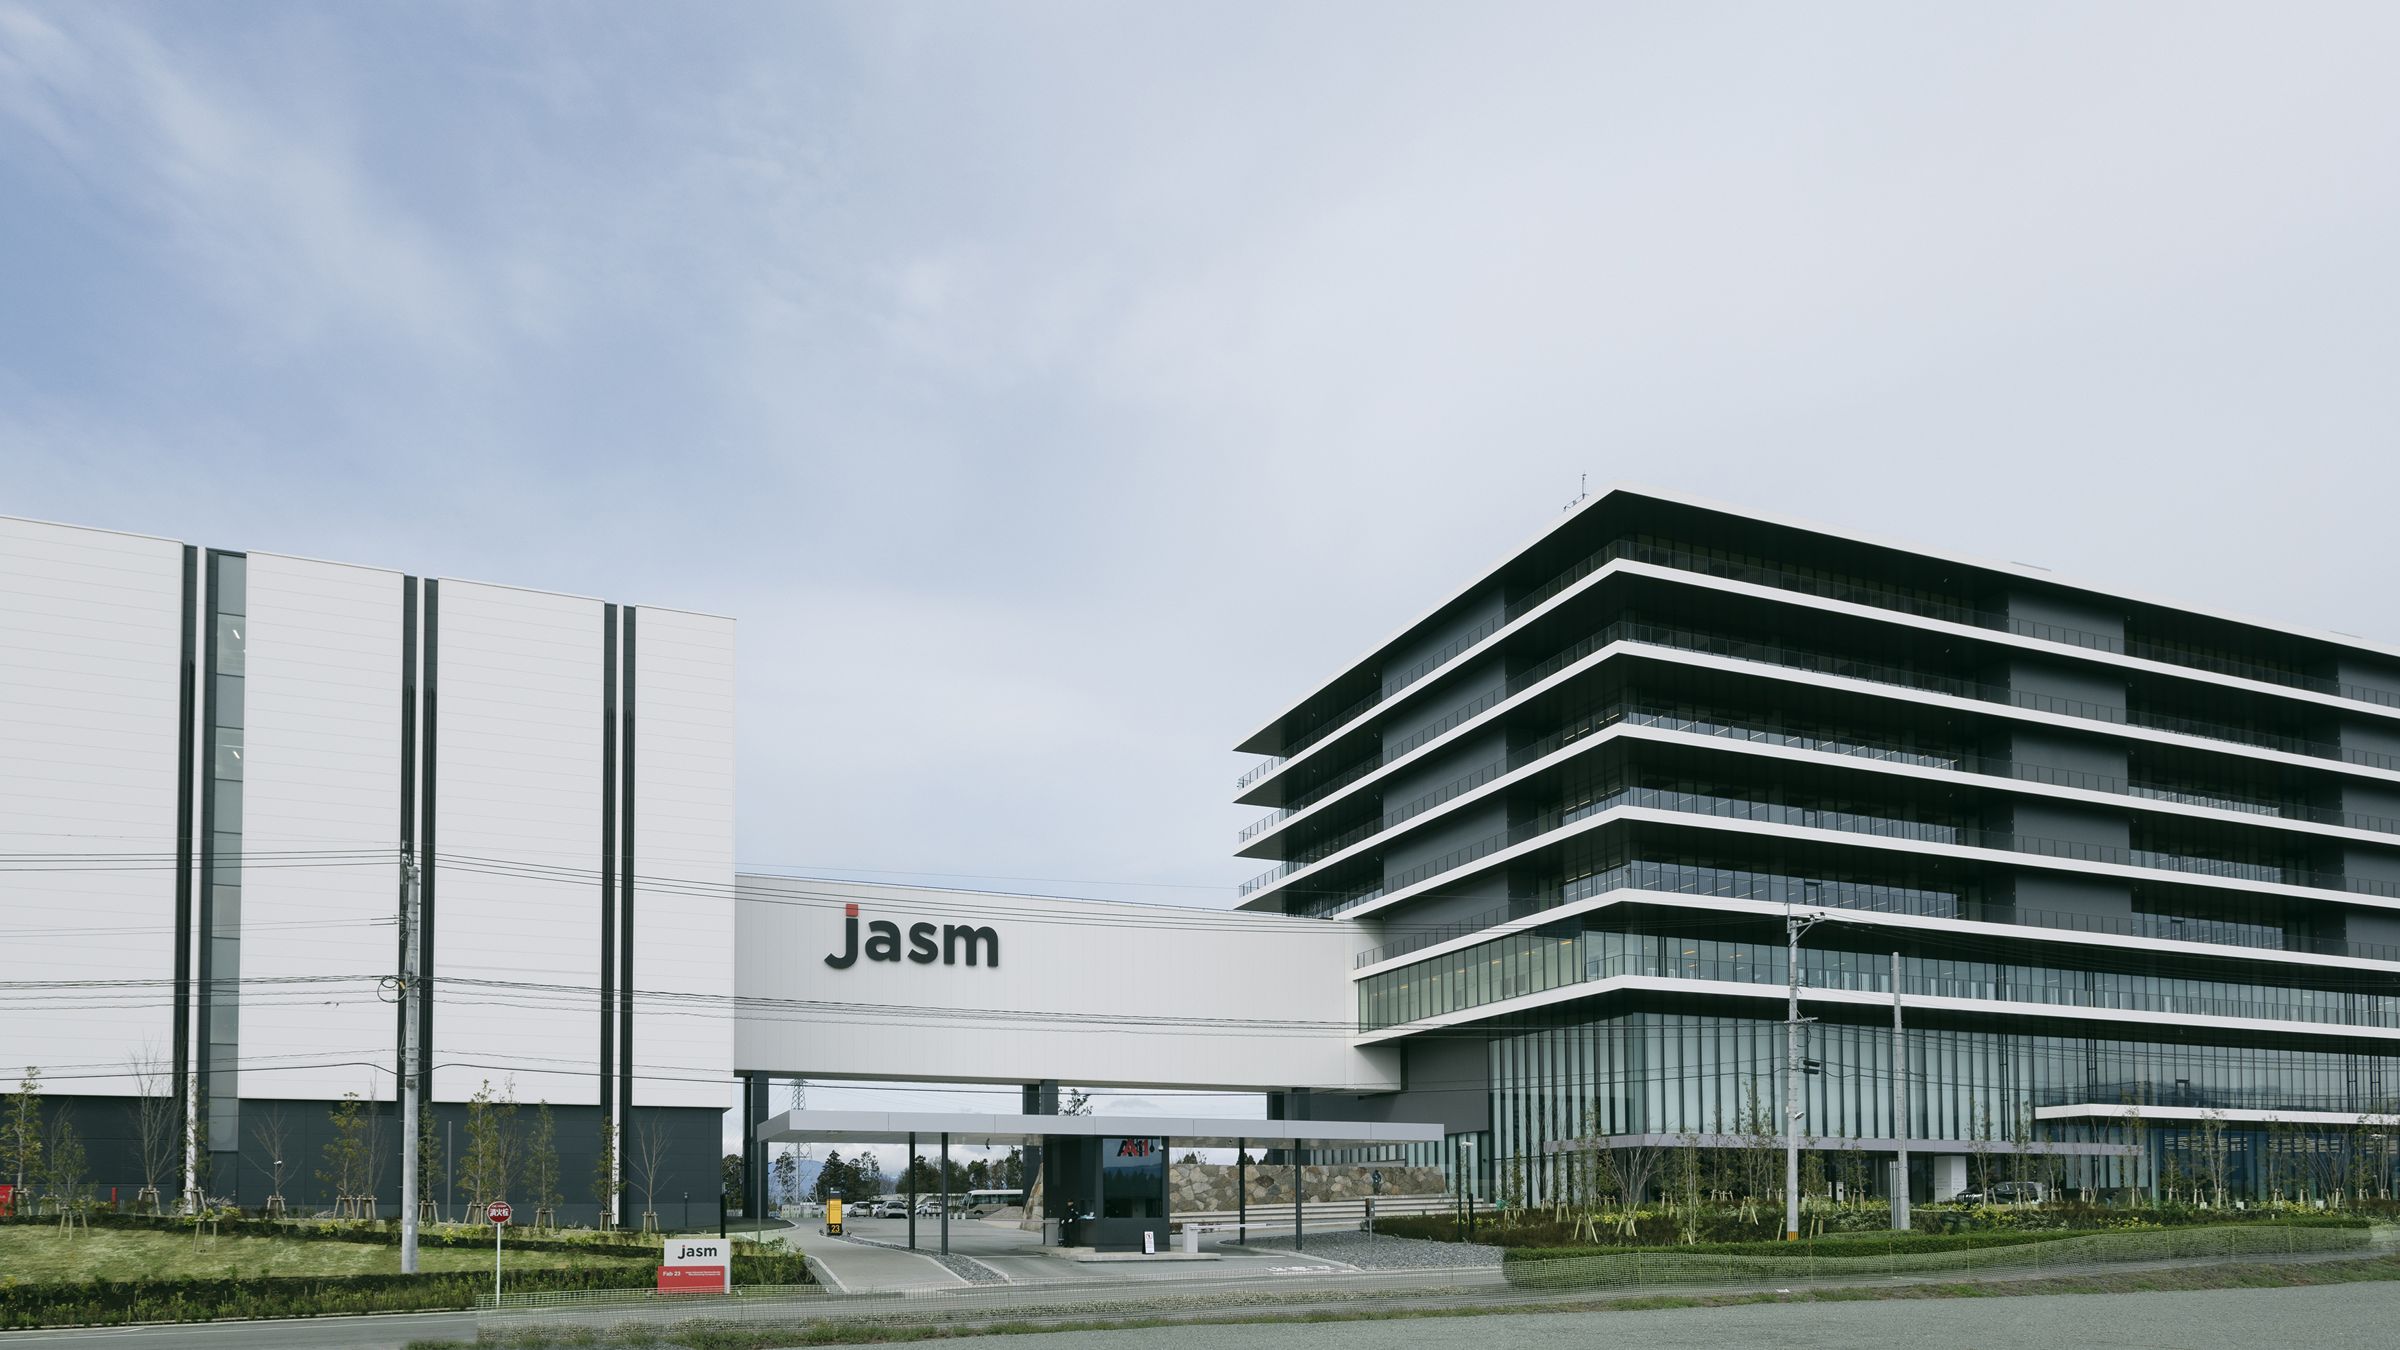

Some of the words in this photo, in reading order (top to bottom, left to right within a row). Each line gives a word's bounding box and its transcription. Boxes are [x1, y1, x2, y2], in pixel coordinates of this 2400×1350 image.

[824, 903, 999, 969] jasm
[831, 1224, 840, 1233] 23
[677, 1244, 718, 1260] jasm
